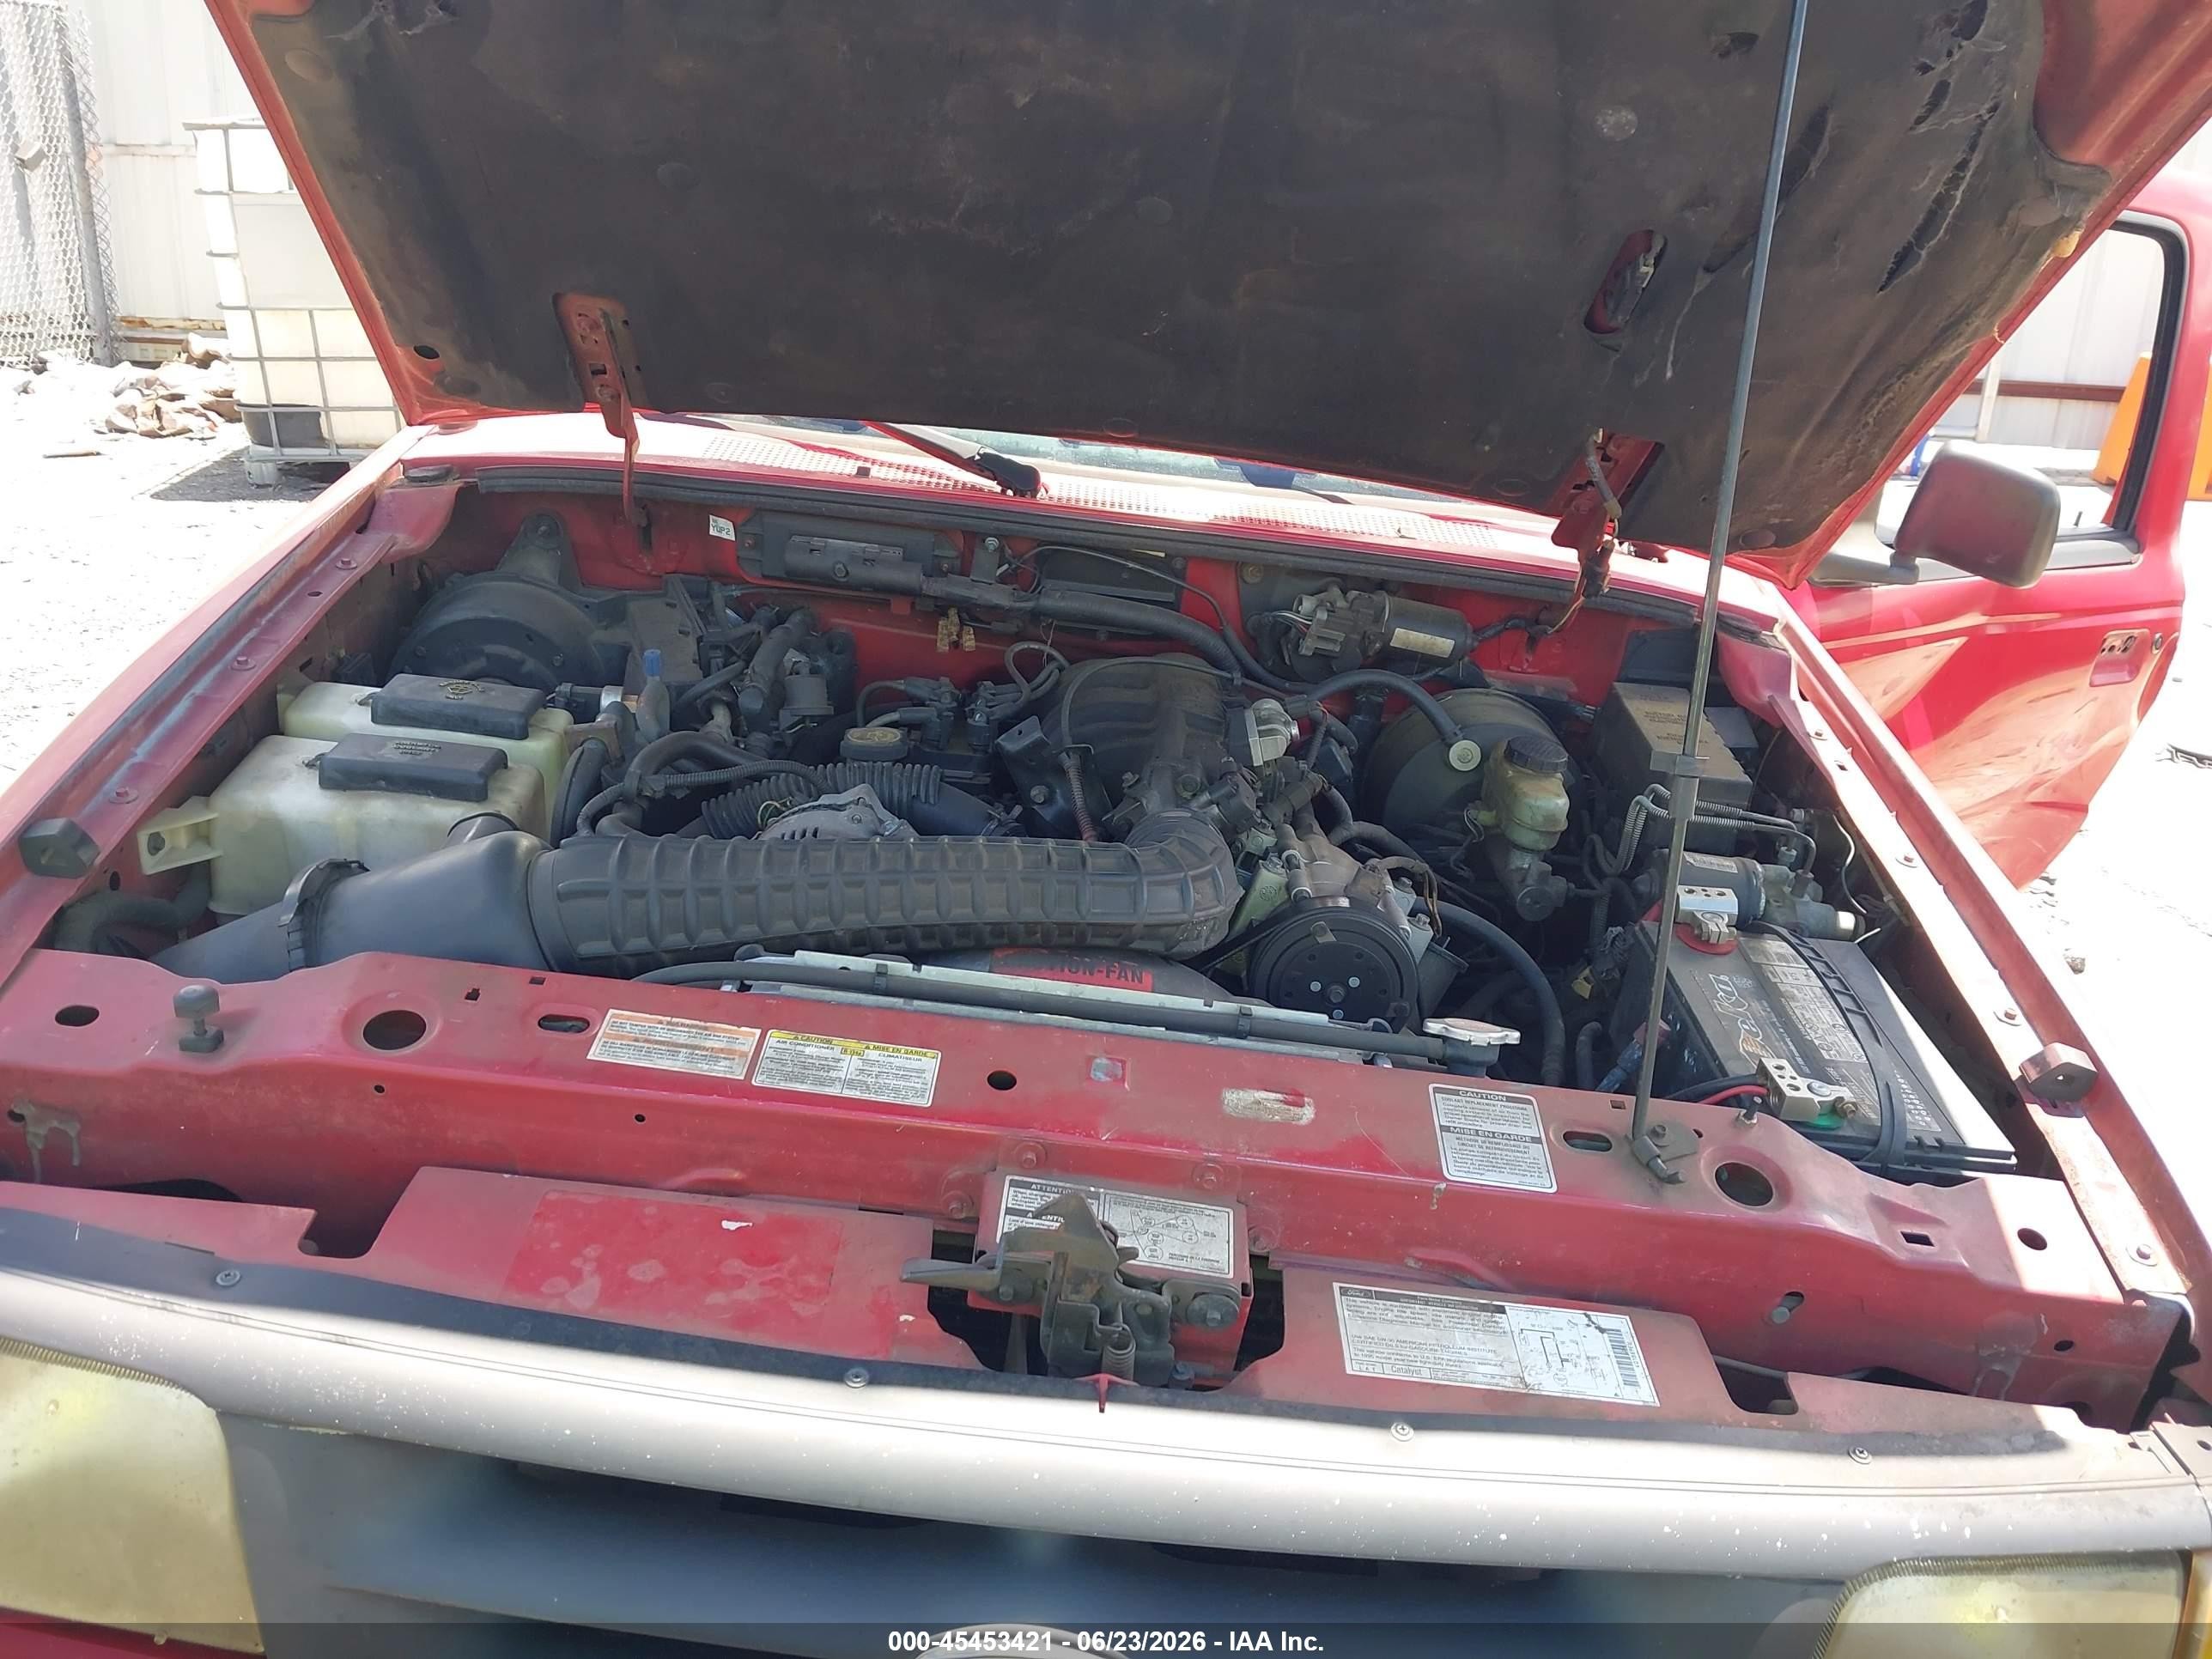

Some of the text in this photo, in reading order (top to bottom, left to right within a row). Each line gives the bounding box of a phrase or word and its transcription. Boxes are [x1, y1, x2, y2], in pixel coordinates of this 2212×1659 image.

[798, 1035, 833, 1044] CAUTION
[788, 1041, 835, 1051] CONDITIONER
[1458, 1090, 1506, 1102] CAUTION
[1449, 1126, 1477, 1135] MISE
[1493, 1132, 1532, 1142] GARDE
[1031, 1184, 1072, 1194] ATTENTIO
[1389, 1364, 1423, 1376] Catalyst
